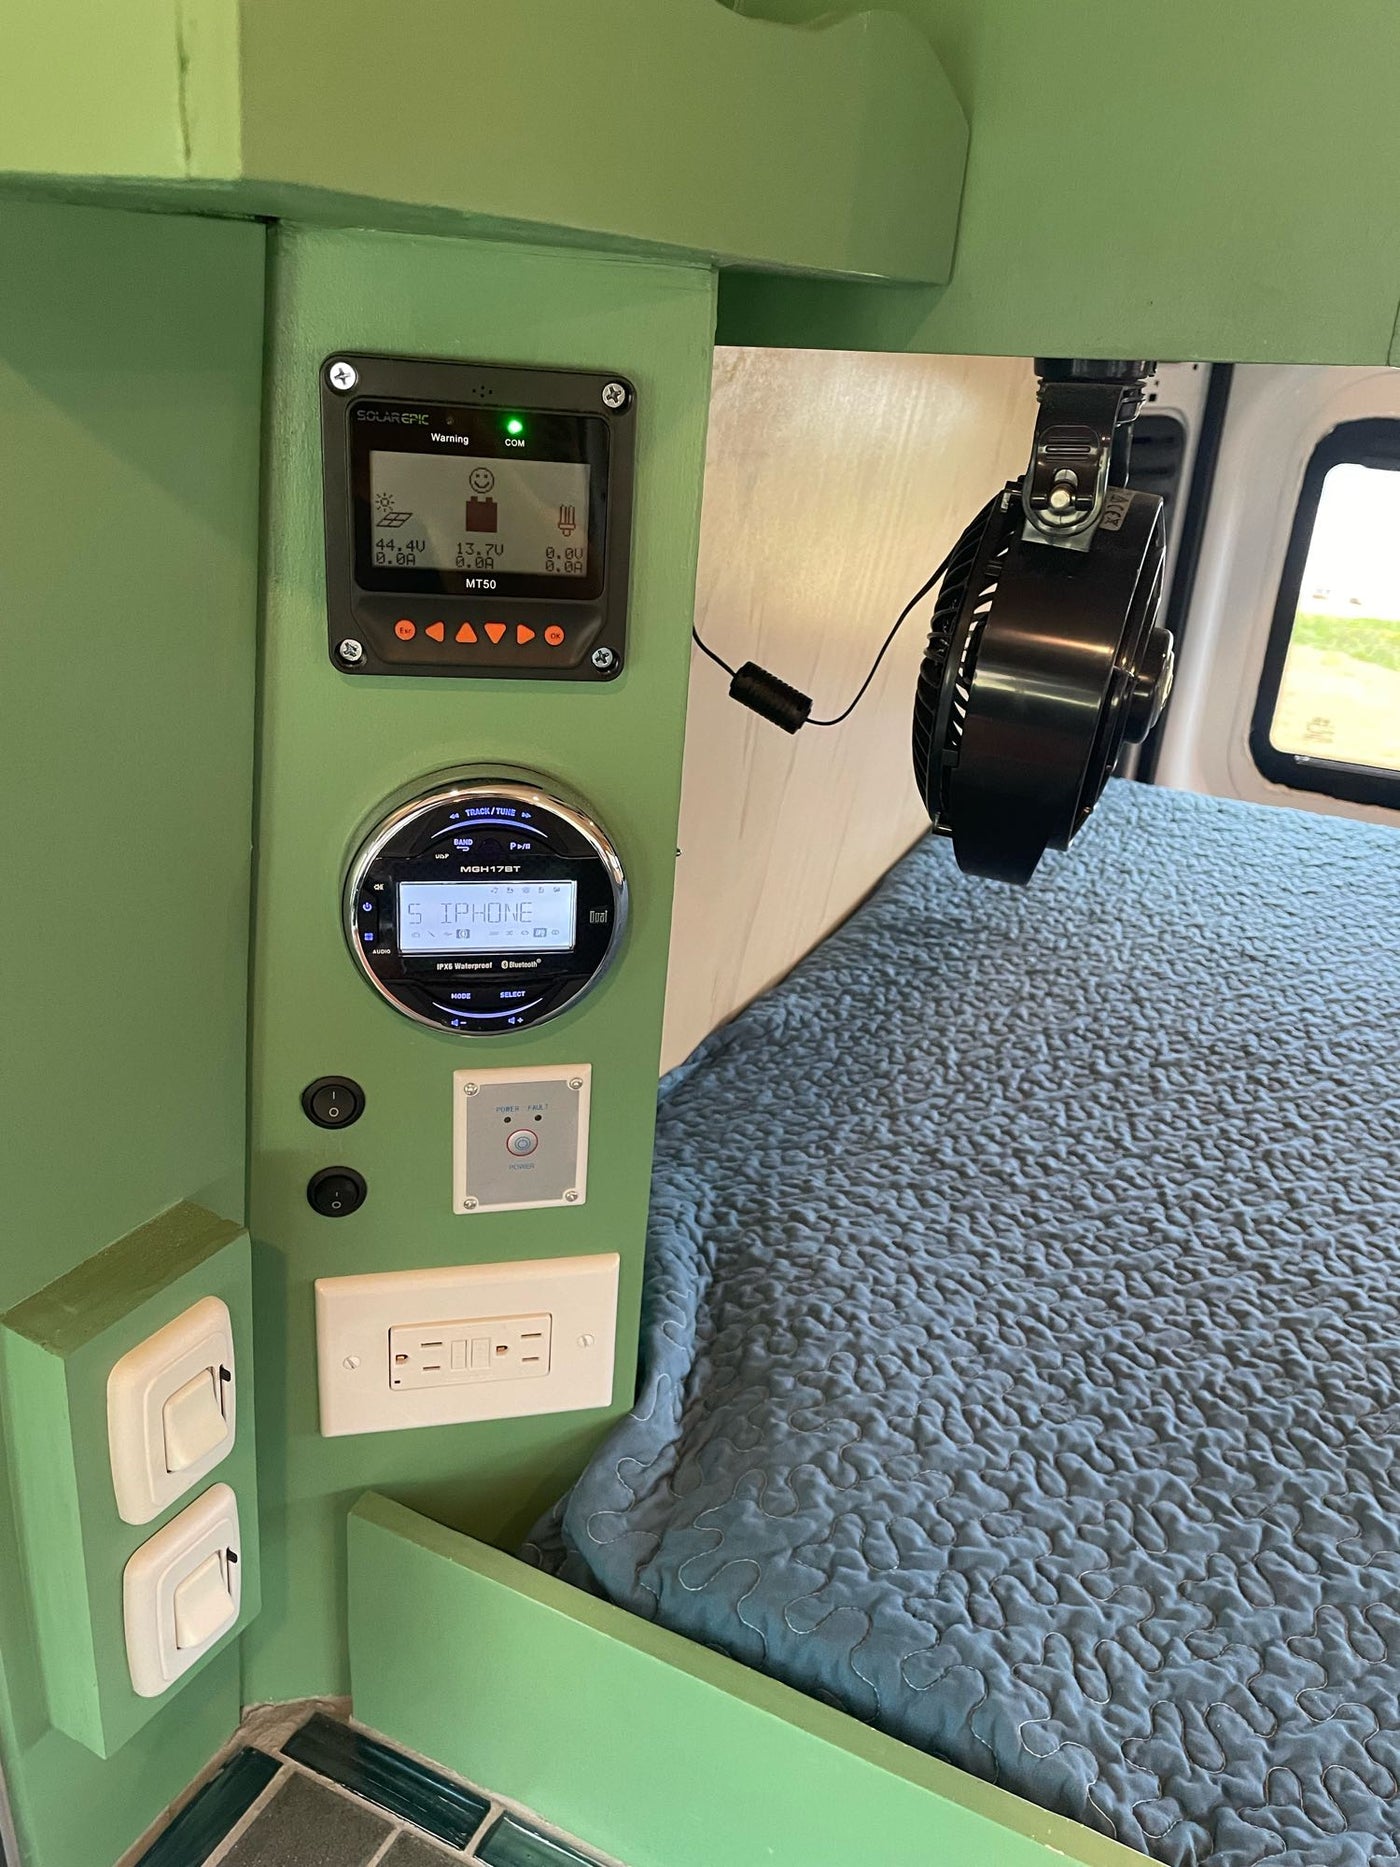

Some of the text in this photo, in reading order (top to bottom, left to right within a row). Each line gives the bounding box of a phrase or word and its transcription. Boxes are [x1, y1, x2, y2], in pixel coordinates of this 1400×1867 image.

[357, 409, 430, 425] SOLAREPIC
[431, 432, 469, 446] Warning
[505, 438, 525, 448] COM
[375, 538, 426, 552] 44.4V
[456, 542, 504, 556] 13.7V
[375, 552, 417, 566] 0.0A
[545, 546, 583, 560] 0.0V
[455, 556, 495, 570] 0.0A
[545, 559, 583, 573] 0.0A
[465, 578, 497, 589] MT50
[453, 838, 473, 846] BAND
[460, 865, 521, 873] MGH17BT
[440, 901, 533, 924] IPHONE
[589, 910, 608, 923] Dual
[454, 962, 493, 970] Waterproof
[500, 990, 526, 998] SELECT
[495, 1105, 520, 1113] POWER
[527, 1103, 549, 1111] FAULT
